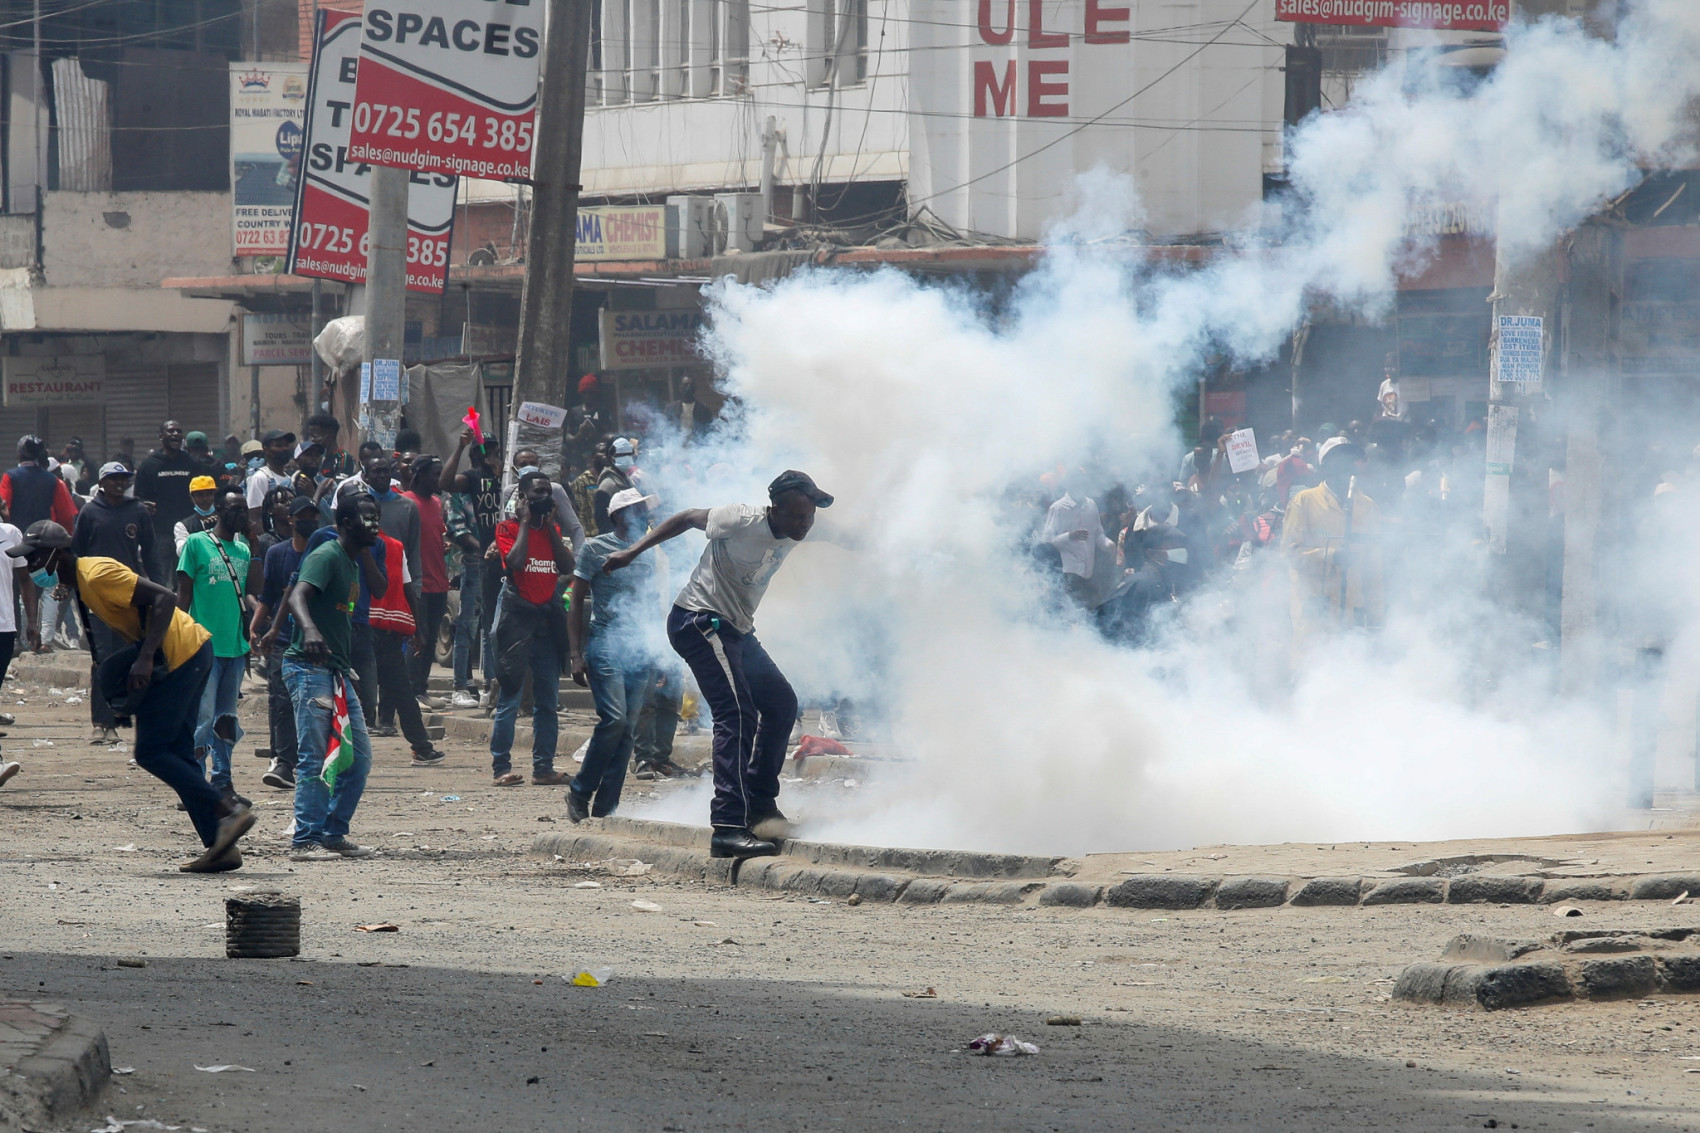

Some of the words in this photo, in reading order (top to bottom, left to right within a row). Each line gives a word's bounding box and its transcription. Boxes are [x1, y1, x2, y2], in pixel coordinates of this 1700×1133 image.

[978, 0, 1130, 48] ULE
[1280, 0, 1506, 25] sales@nudgim-signage.co.ke
[365, 9, 539, 58] SPACES
[339, 57, 358, 83] B
[974, 59, 1069, 117] ME
[235, 108, 251, 118] ROYAL
[326, 100, 351, 127] T
[354, 102, 421, 139] 0725
[427, 112, 477, 146] 654
[483, 117, 532, 152] 385
[351, 142, 530, 178] sales@nudgim-signage.co.ke
[236, 208, 259, 216] FREE
[261, 208, 292, 217] DELIVE
[237, 220, 280, 228] COUNTRY
[236, 230, 259, 244] 0722
[263, 230, 275, 244] 63
[575, 214, 602, 243] AMA
[605, 212, 659, 243] CHEMIST
[299, 222, 354, 254] 0725
[407, 237, 448, 267] 385
[253, 348, 286, 359] PARCEL
[288, 347, 312, 358] SERV
[9, 381, 103, 393] RESTAURANT
[526, 413, 551, 426] LAIS
[477, 492, 501, 509] YOU
[529, 557, 550, 567] Team
